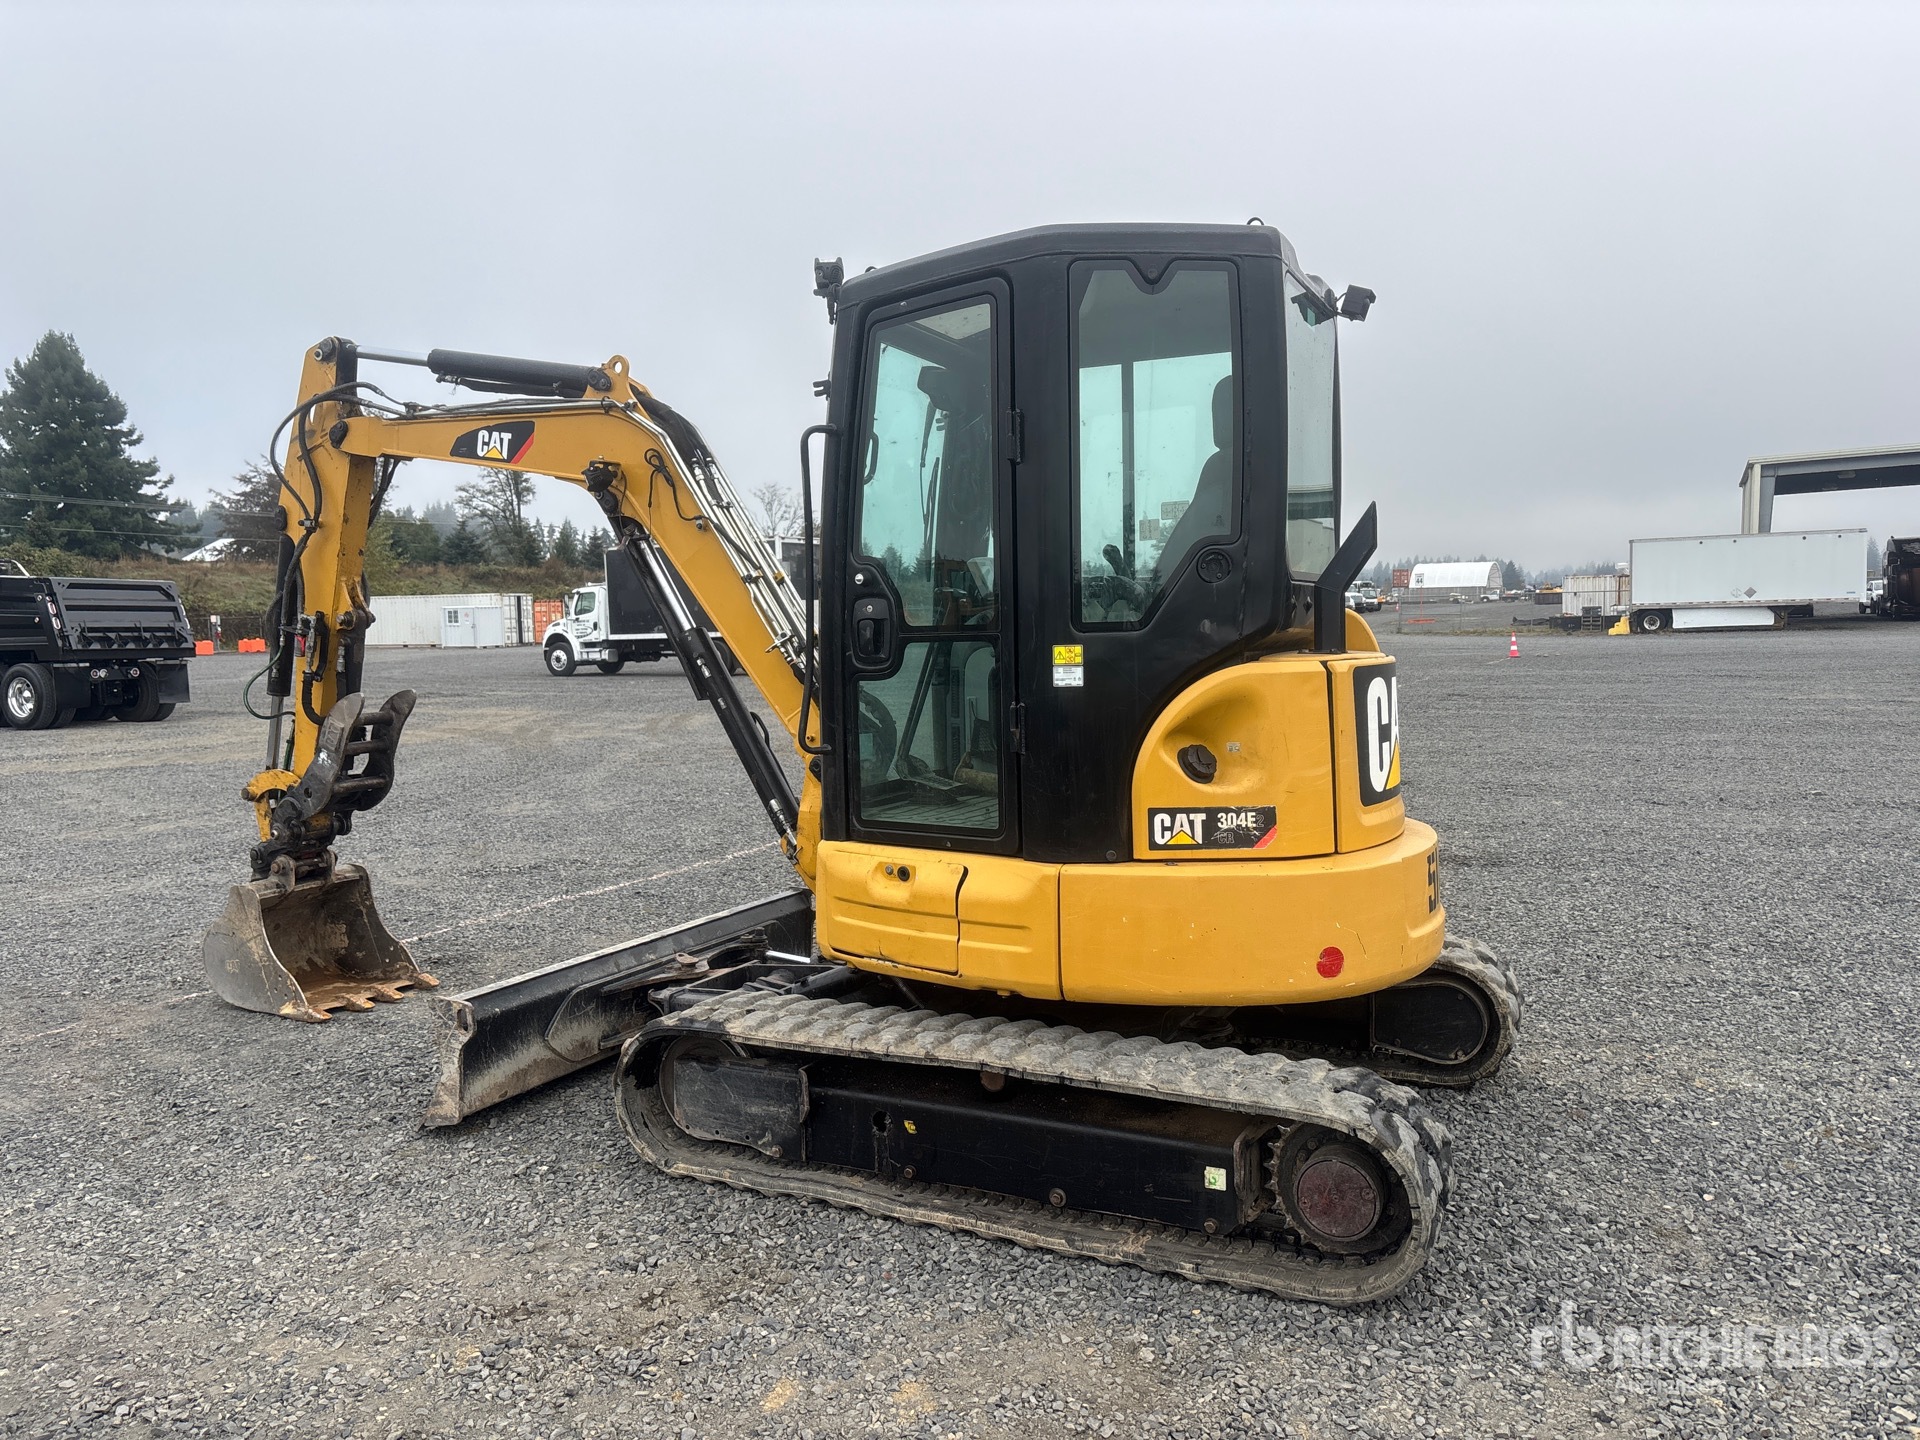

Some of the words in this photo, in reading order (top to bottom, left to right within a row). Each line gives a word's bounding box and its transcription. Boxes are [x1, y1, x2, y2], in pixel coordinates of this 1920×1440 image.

[476, 429, 512, 460] CAT
[1367, 676, 1400, 793] CA
[1153, 813, 1206, 845] CAT
[1426, 847, 1439, 914] 5
